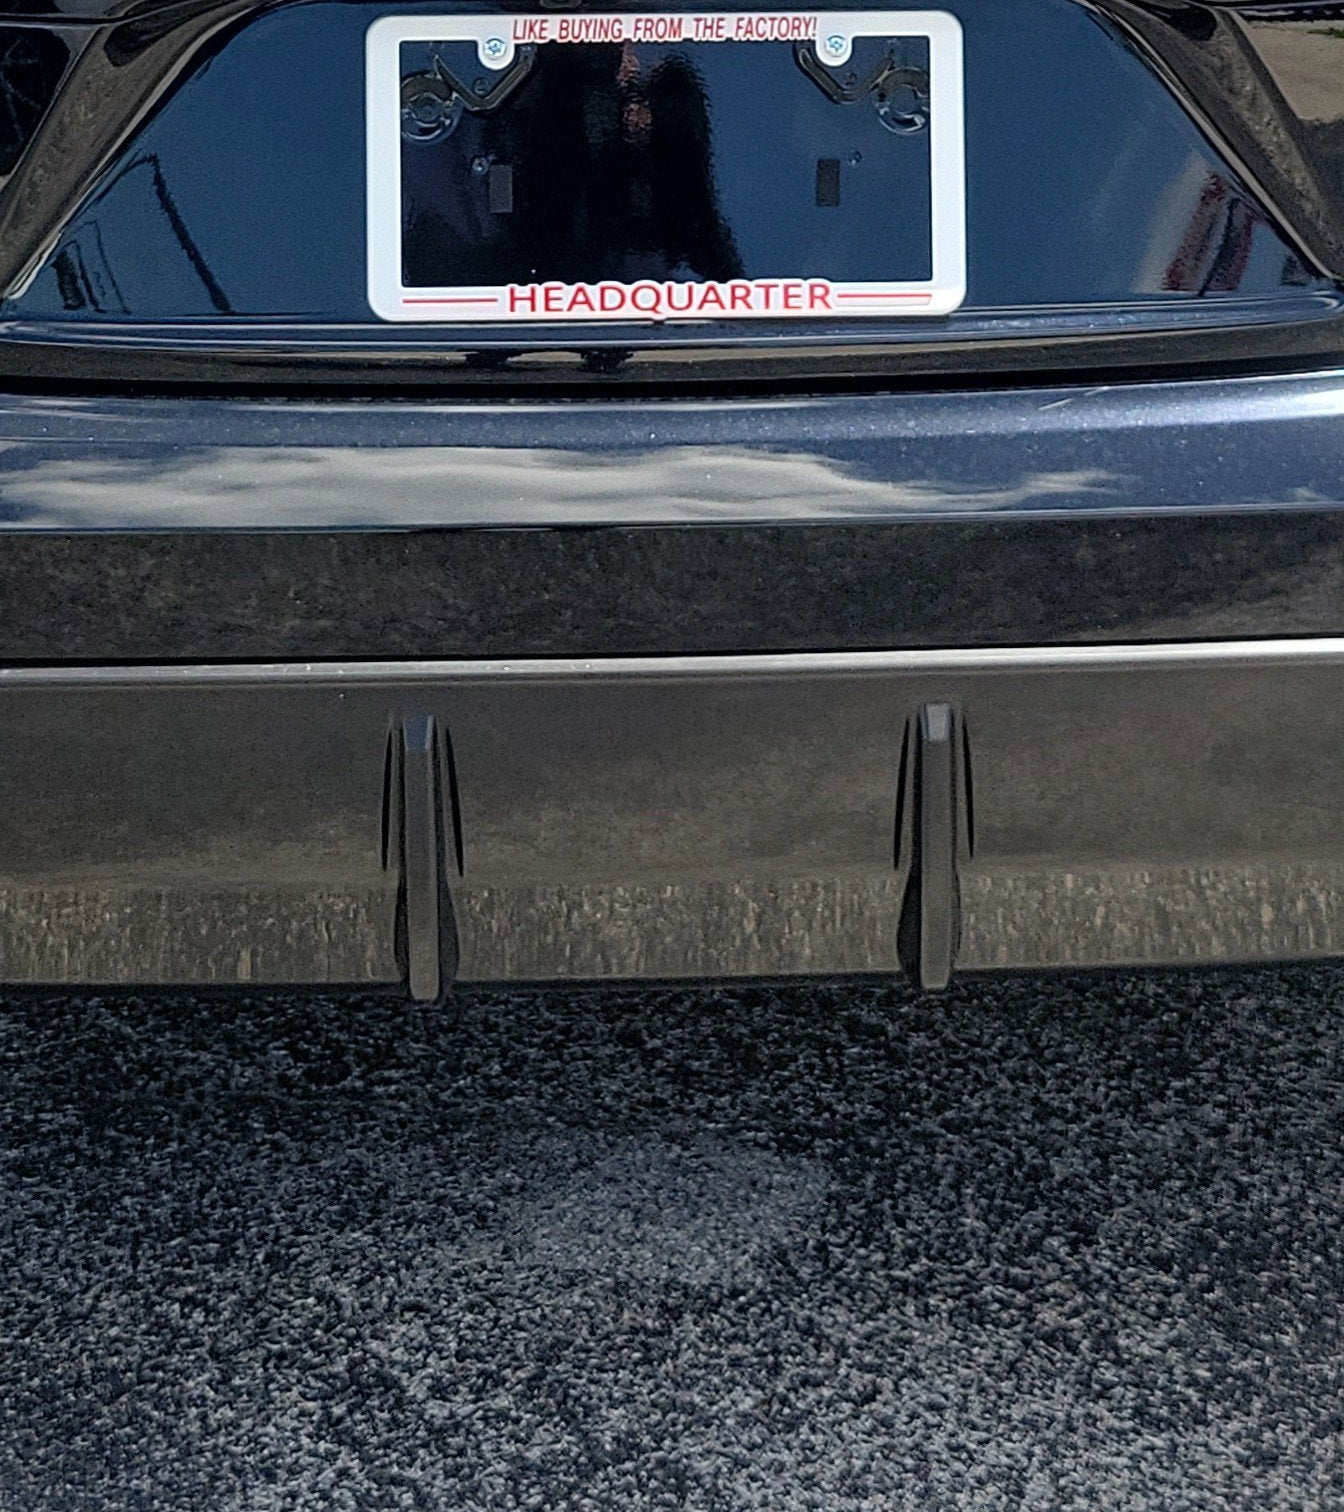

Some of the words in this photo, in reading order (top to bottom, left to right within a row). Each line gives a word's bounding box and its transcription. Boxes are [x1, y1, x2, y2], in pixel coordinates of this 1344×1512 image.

[512, 18, 549, 40] LIKE
[559, 17, 623, 40] BUYING
[632, 17, 683, 39] FROM
[693, 17, 725, 39] THE
[735, 16, 818, 39] FACTORY!
[508, 282, 833, 314] HEADQUARTER
